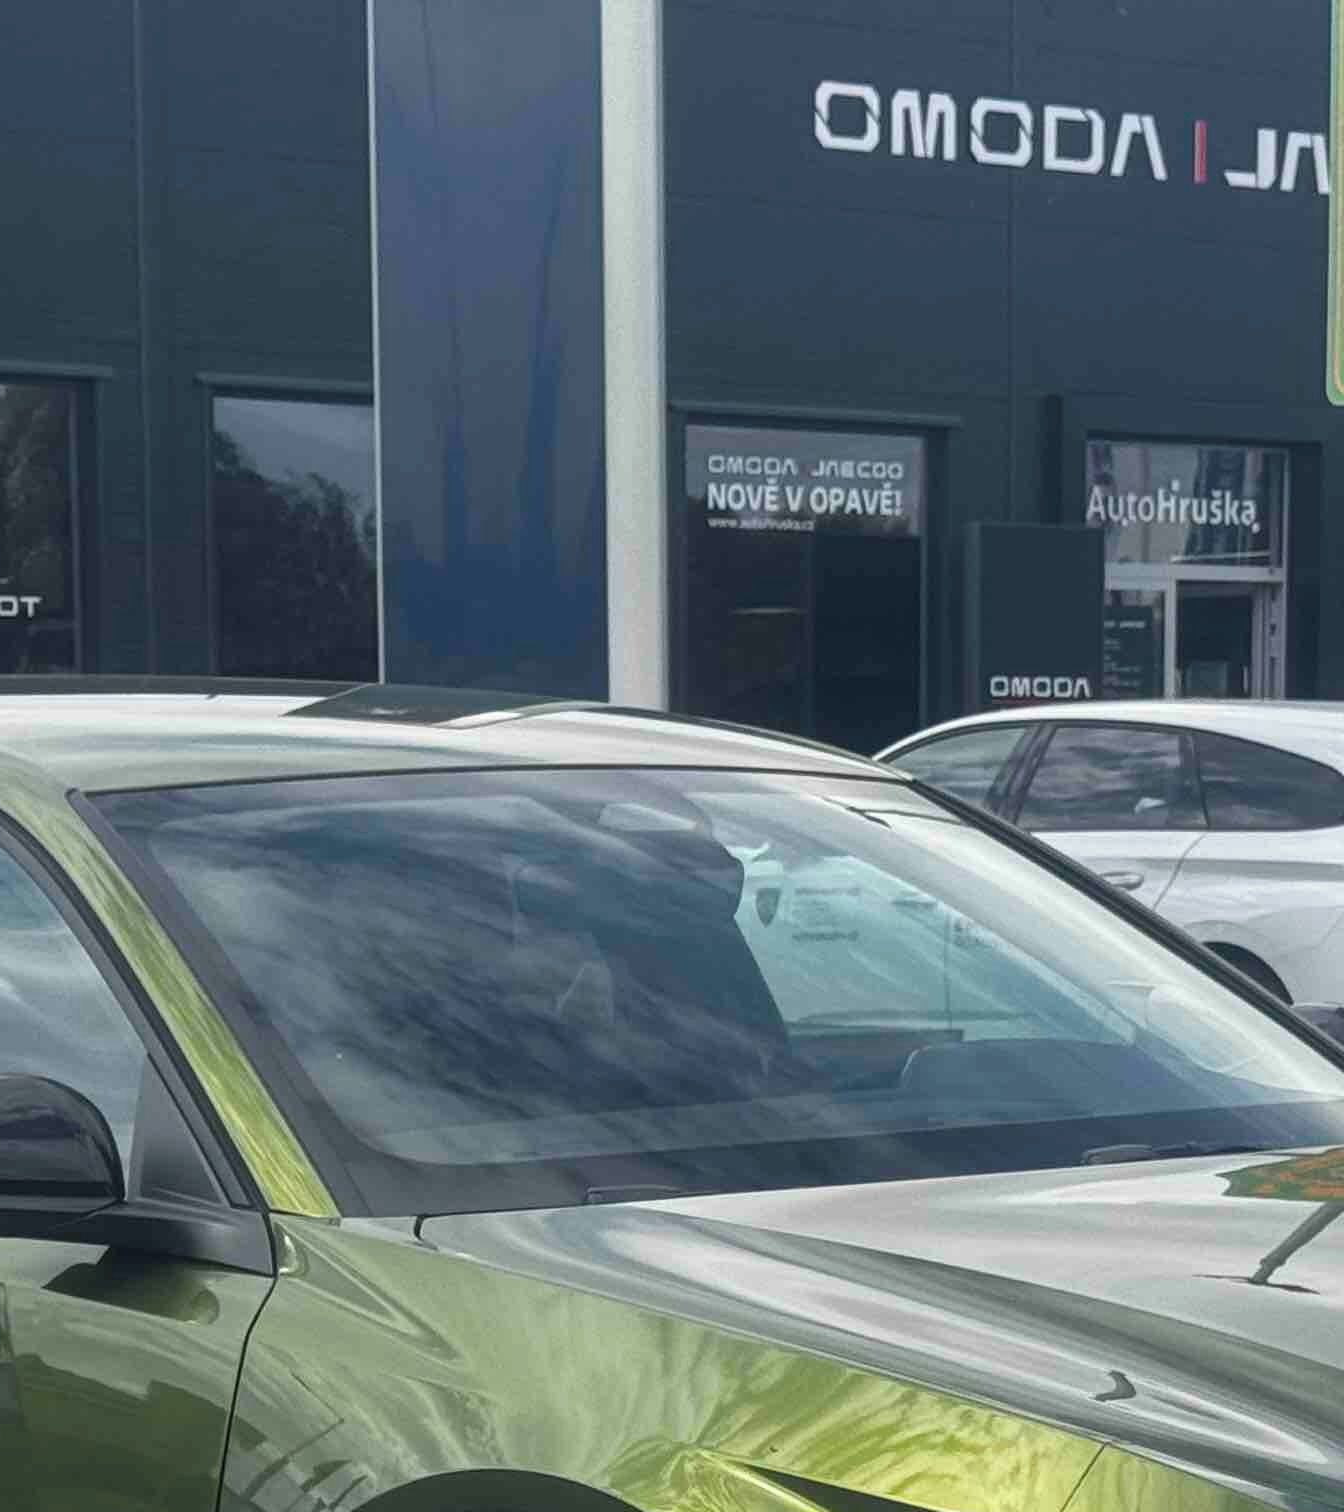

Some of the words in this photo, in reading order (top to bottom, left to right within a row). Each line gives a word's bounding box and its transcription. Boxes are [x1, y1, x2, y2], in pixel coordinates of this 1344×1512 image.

[814, 80, 1169, 182] OMODA
[708, 455, 799, 475] OMODA
[785, 487, 805, 513] V
[989, 675, 1091, 698] OMODA
